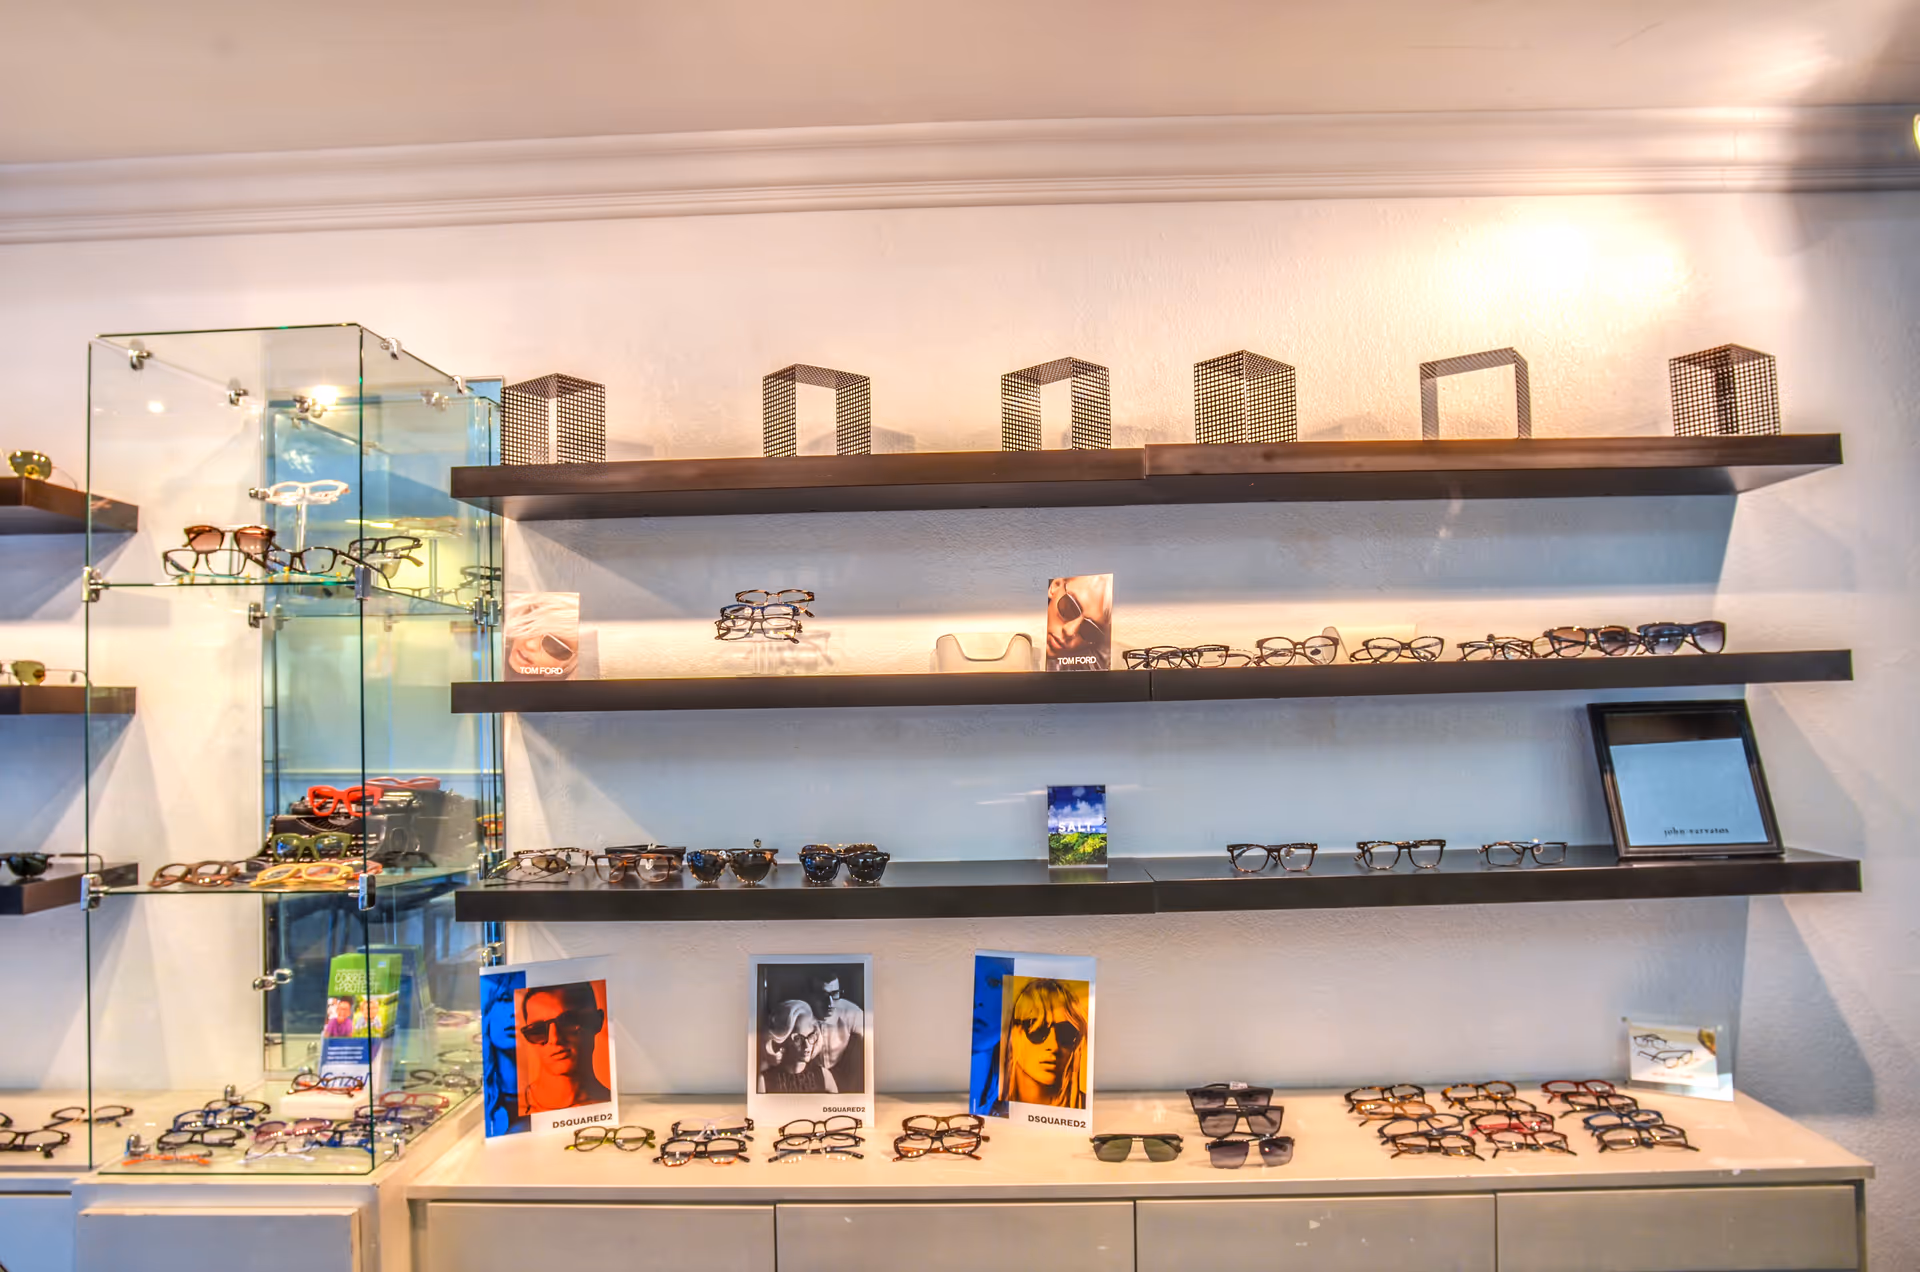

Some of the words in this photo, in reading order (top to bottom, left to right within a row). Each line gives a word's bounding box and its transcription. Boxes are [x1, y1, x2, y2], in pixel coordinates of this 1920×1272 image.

[1057, 657, 1075, 665] TOM
[1075, 656, 1097, 665] FORD
[519, 666, 539, 675] TOM
[540, 666, 563, 675] FORD
[552, 1113, 613, 1129] DSQUARED2
[1028, 1114, 1087, 1129] DSQUARED2
